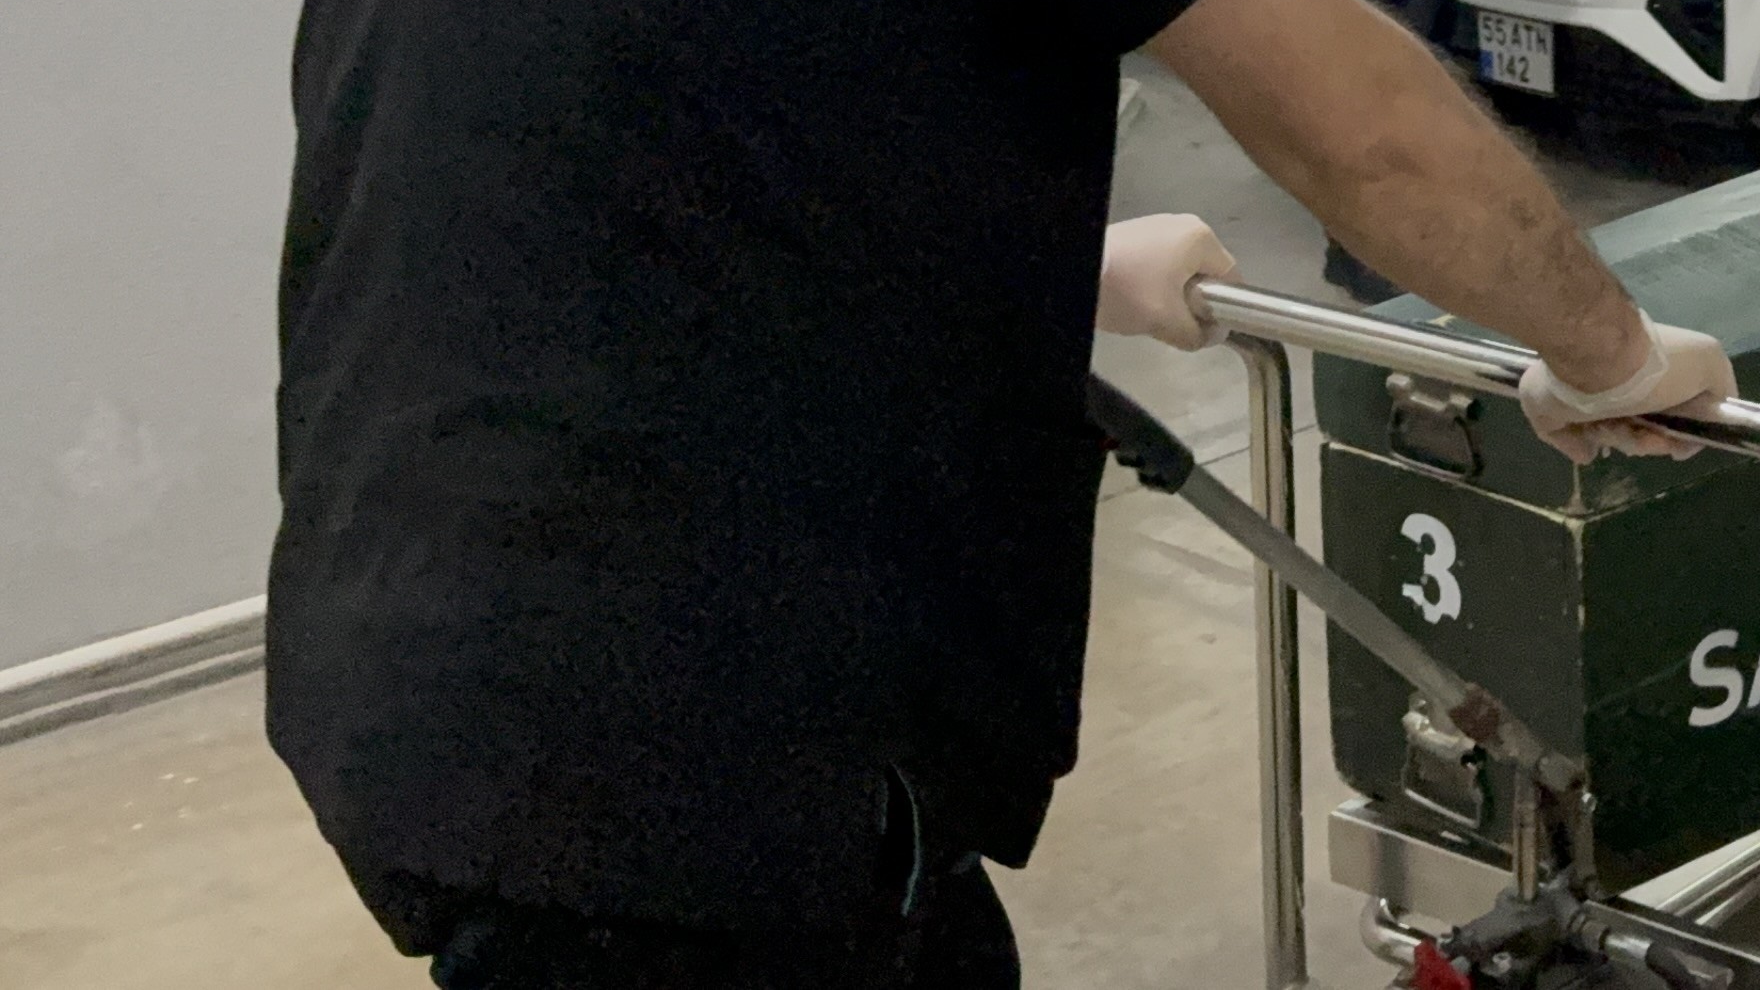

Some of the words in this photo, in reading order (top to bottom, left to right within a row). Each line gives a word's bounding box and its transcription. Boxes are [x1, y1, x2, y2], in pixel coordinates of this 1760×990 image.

[1482, 15, 1507, 46] 55
[1496, 52, 1530, 83] 142
[1401, 513, 1462, 625] 3
